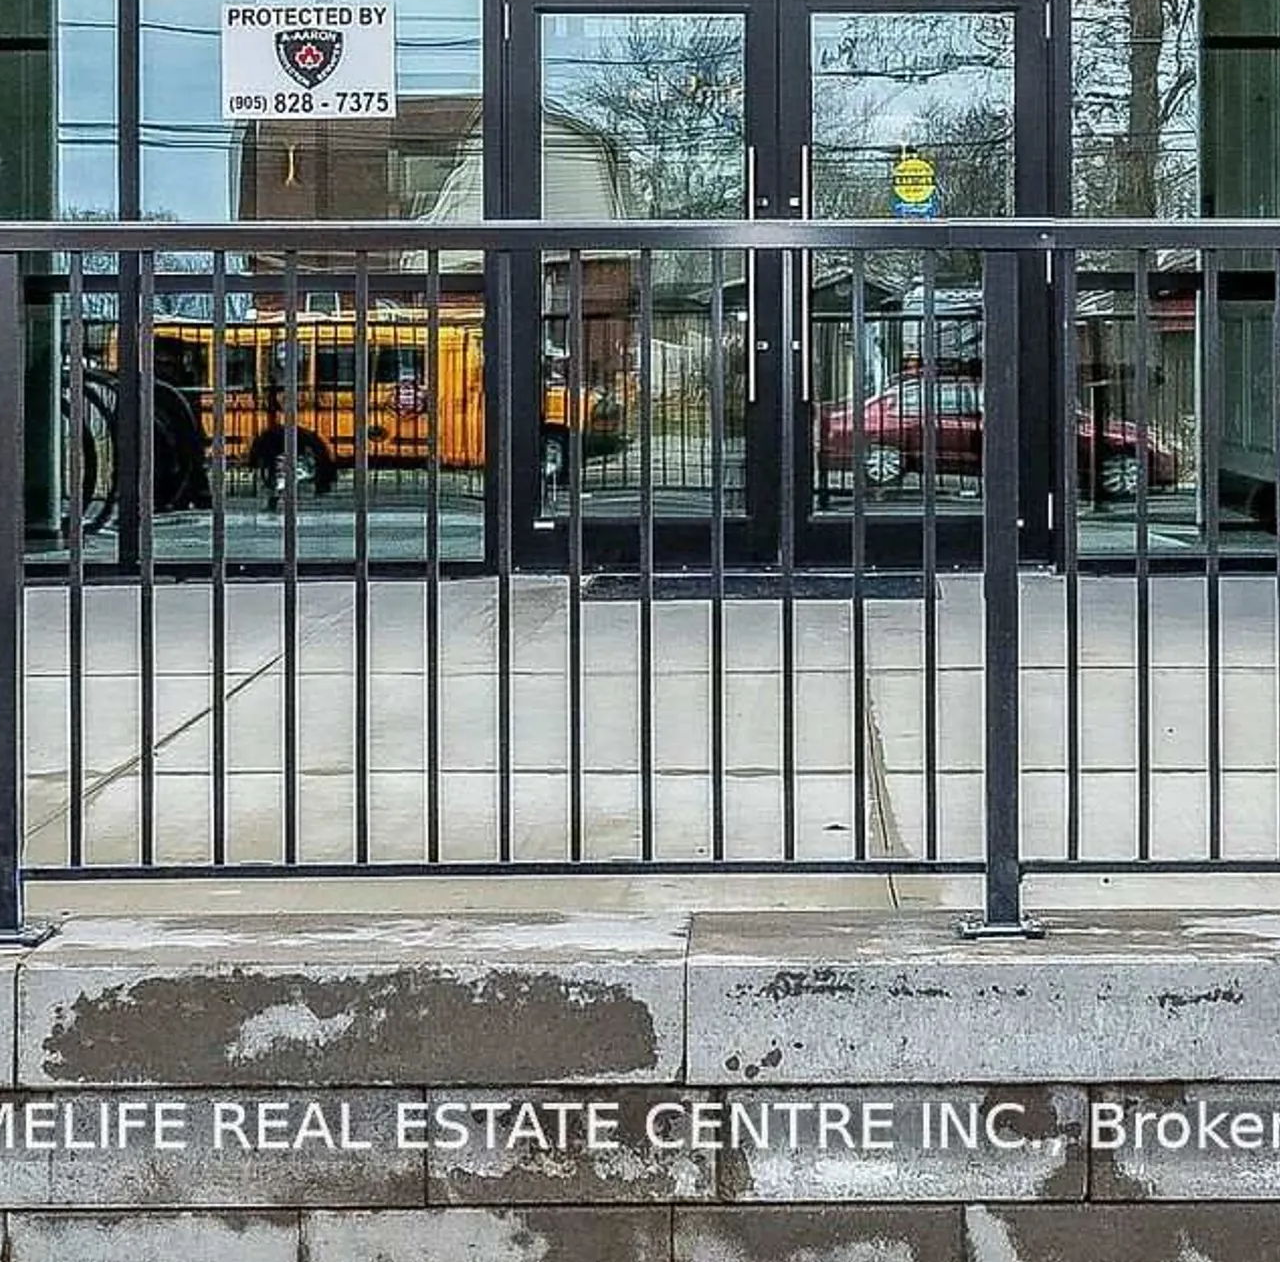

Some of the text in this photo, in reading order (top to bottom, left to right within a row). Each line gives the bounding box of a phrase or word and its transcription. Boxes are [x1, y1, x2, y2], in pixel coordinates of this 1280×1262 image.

[228, 7, 387, 26] PROTECTED BY
[229, 96, 267, 112] (905)
[274, 92, 314, 113] 828
[336, 92, 389, 113] 7375
